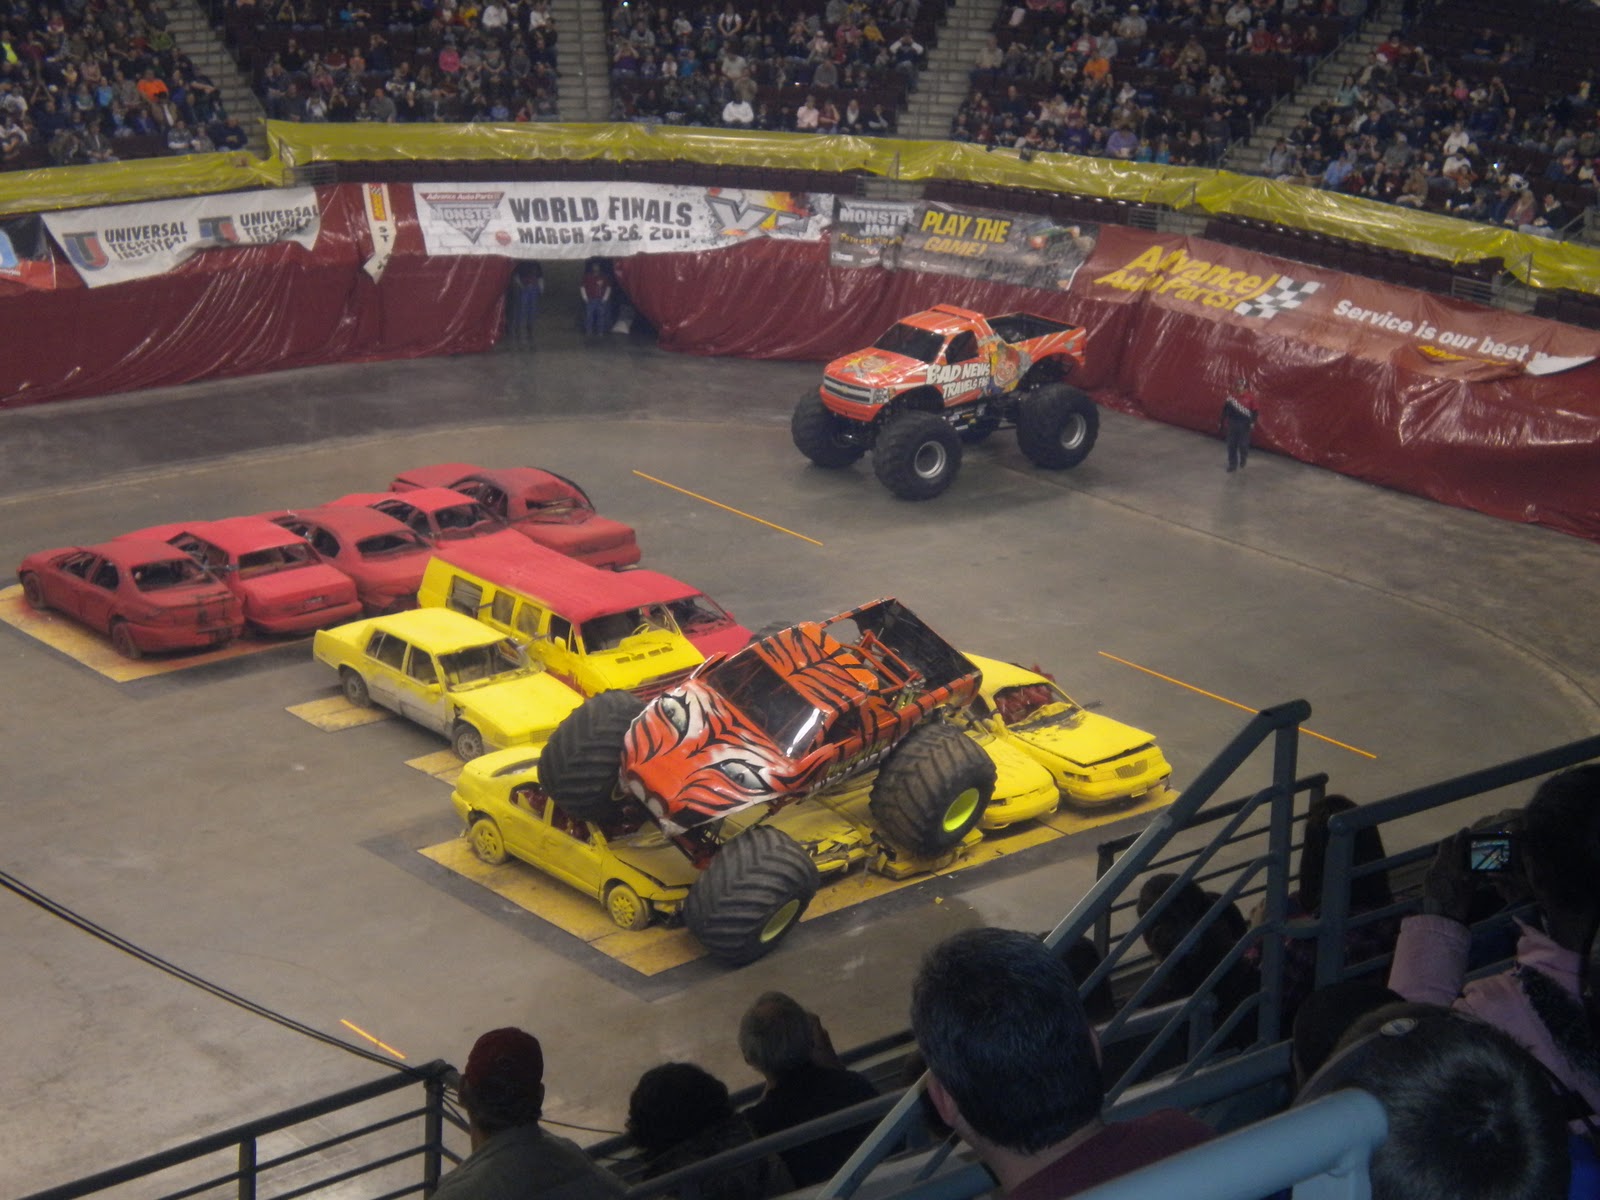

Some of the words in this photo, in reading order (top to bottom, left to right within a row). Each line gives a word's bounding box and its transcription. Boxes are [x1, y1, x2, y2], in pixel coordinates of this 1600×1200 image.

[240, 204, 320, 227] UNIVERSAL
[508, 196, 600, 223] WORLD
[608, 195, 692, 227] FINALS
[104, 221, 188, 243] UNIVERSAL
[517, 226, 585, 244] MARCH
[649, 226, 691, 241] 2011
[859, 223, 896, 236] JAM
[920, 210, 972, 238] PLAY
[973, 217, 1011, 243] THE
[923, 236, 988, 257] GAME!
[1333, 299, 1414, 335] Service
[1413, 319, 1437, 341] is
[1437, 331, 1479, 350] our
[1477, 335, 1530, 363] best
[926, 364, 962, 384] BAD
[961, 362, 990, 379] NEWS
[942, 378, 978, 398] TRAVELS
